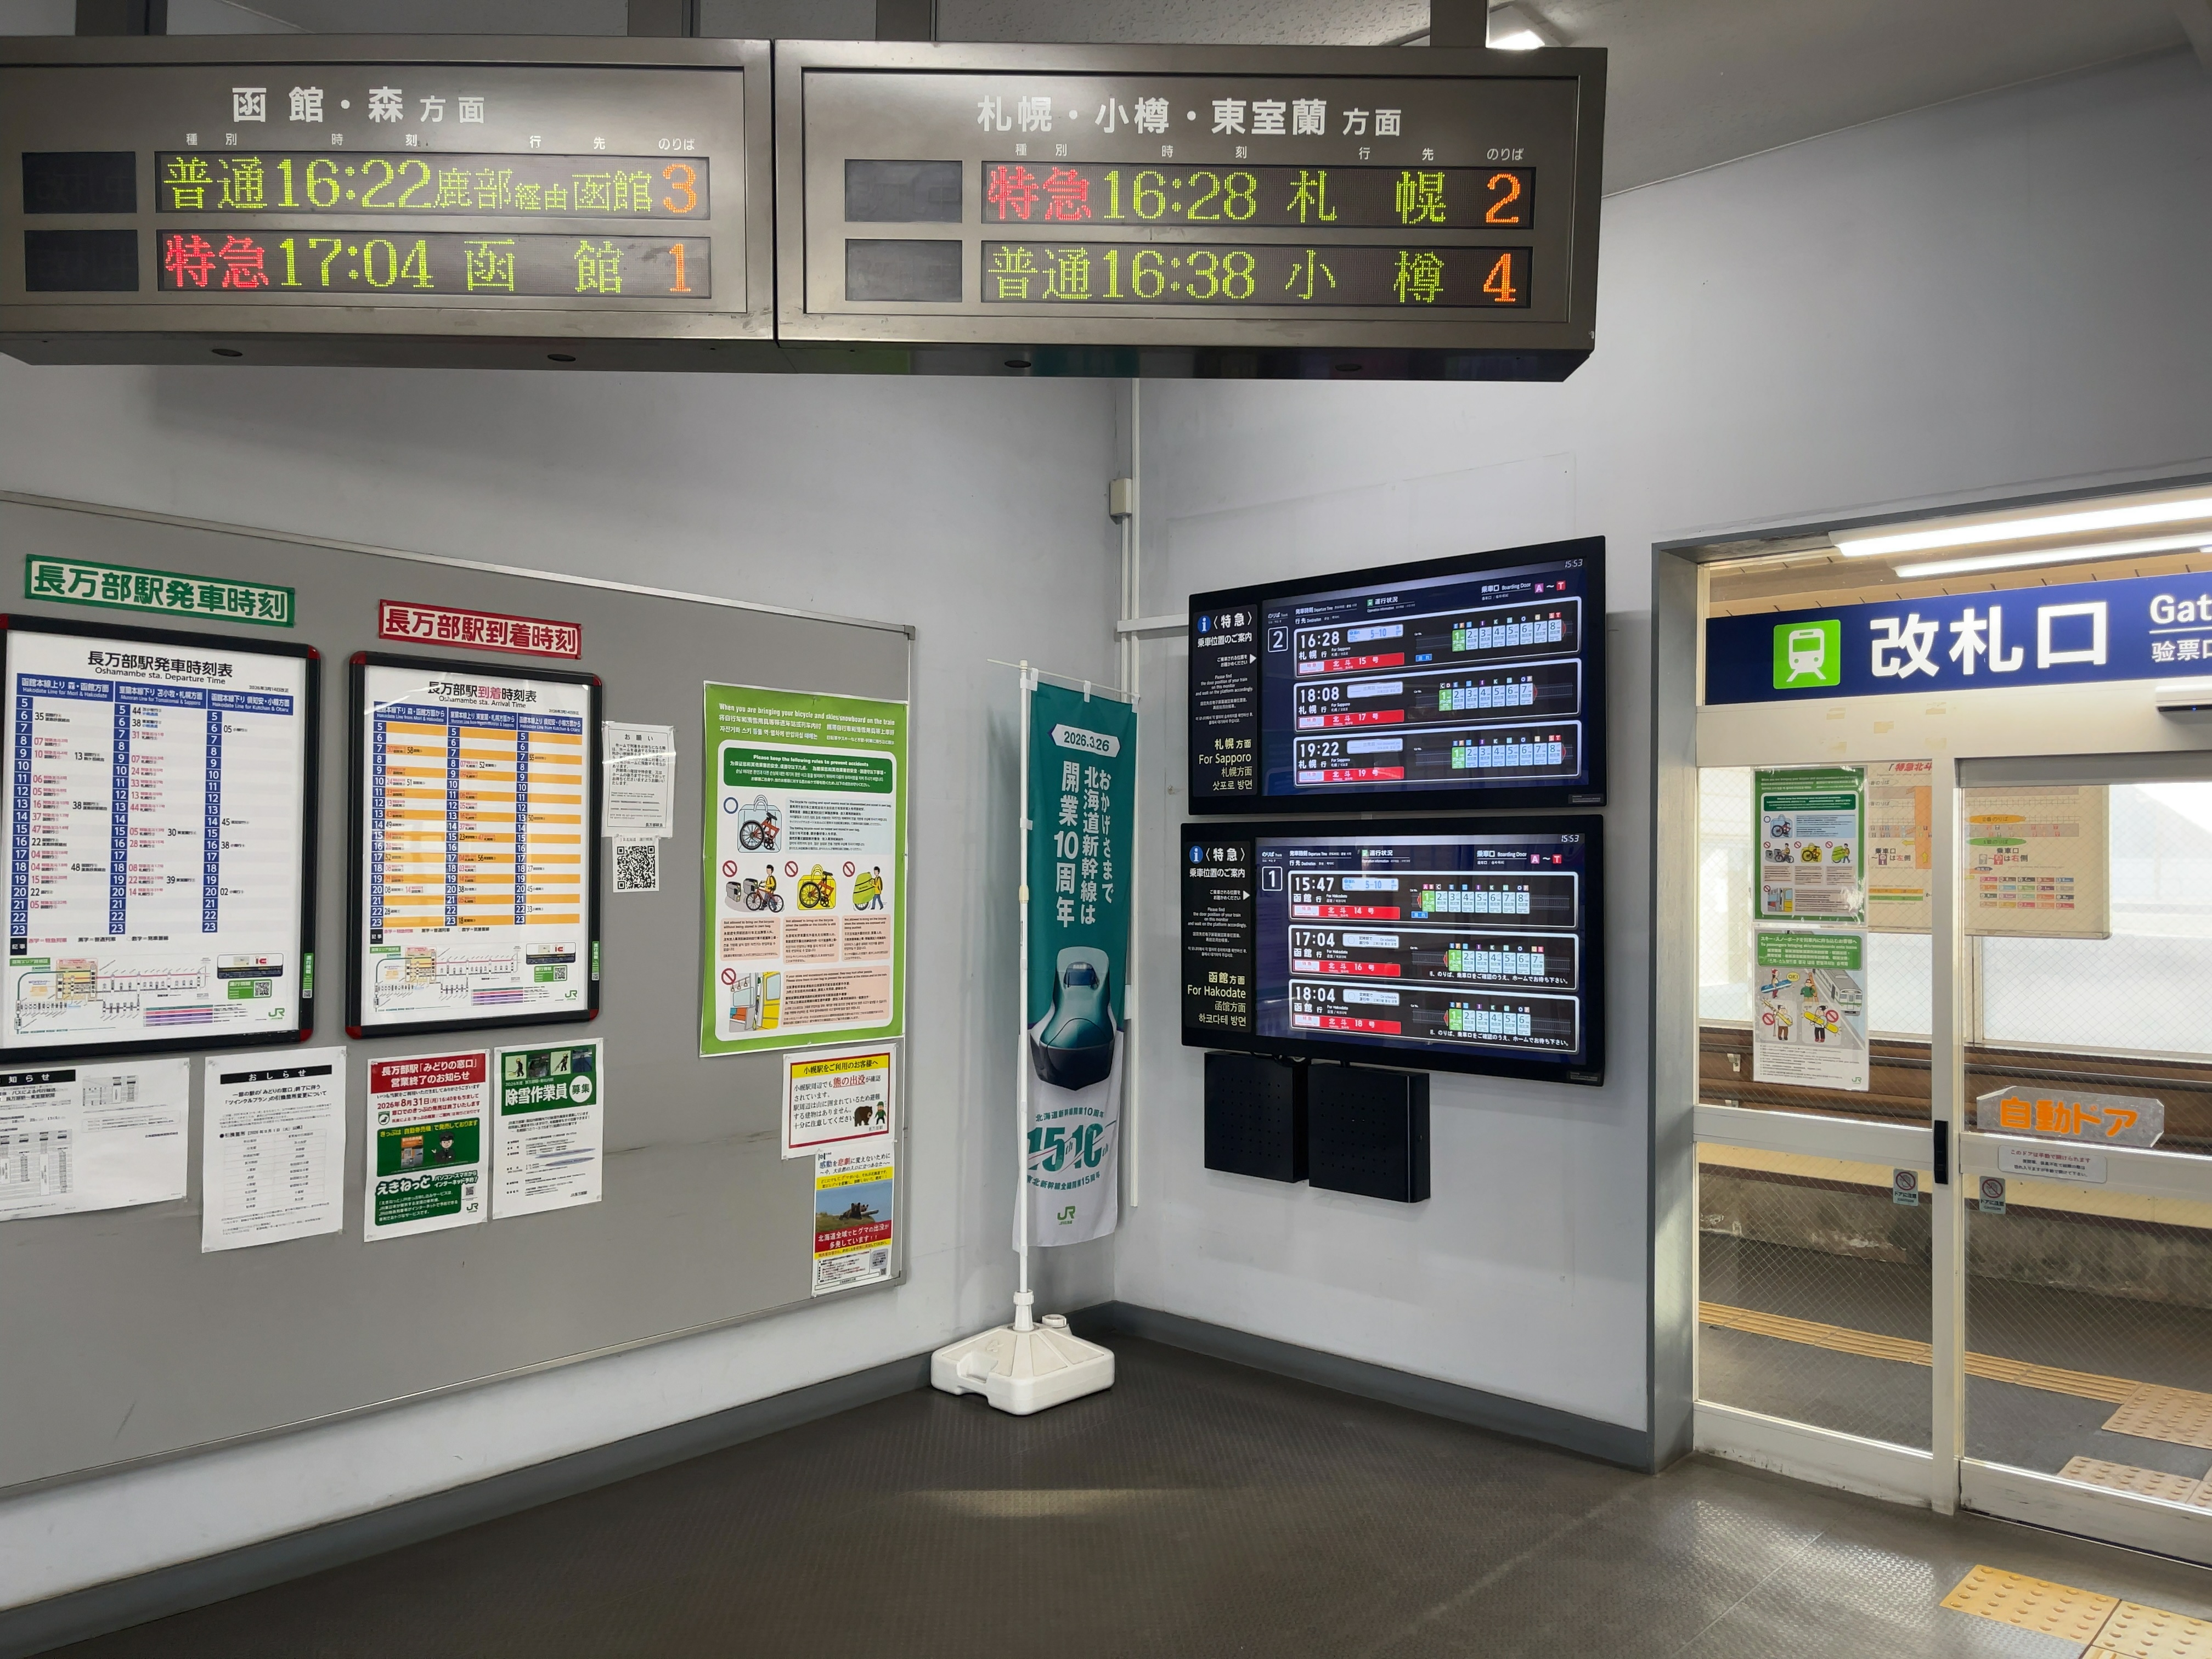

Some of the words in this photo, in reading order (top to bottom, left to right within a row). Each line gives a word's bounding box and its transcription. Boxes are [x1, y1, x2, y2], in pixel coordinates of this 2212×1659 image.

[186, 133, 238, 146] 種別
[331, 133, 417, 147] 時刻
[529, 136, 605, 150] 行先
[658, 137, 696, 152] のりば
[1015, 143, 1068, 156] 種別
[1161, 145, 1248, 159] 時刻
[1358, 146, 1434, 162] 行先
[1486, 147, 1524, 162] のりば
[163, 156, 266, 210] 普通
[277, 158, 432, 208] 16:22
[661, 163, 697, 213] 3
[988, 166, 1092, 221] 特急
[1102, 170, 1258, 221] 16:28
[1286, 171, 1447, 224] 札幌
[1485, 172, 1522, 224] 2
[163, 234, 268, 289] 特急
[280, 238, 433, 289] 17:04
[464, 239, 624, 294] 函館
[668, 244, 691, 292] 1
[988, 245, 1091, 301] 普通
[1102, 249, 1257, 299] 16:38
[1285, 250, 1444, 303] 小樽
[1483, 253, 1516, 303] 4
[1565, 558, 1583, 568] 15:53
[34, 565, 287, 620] 長万部駅発車時刻
[386, 608, 577, 654] 長万部駅到着時刻
[1273, 630, 1283, 648] 2
[1198, 632, 1252, 647] 乗車位置のご案内
[1301, 631, 1339, 648] 16:28
[1870, 601, 2109, 679] 改札口
[88, 651, 233, 678] 長万部駅発車時刻表
[95, 667, 146, 678] Oshamambe
[165, 673, 204, 683] Departure
[207, 676, 225, 685] Time
[427, 681, 537, 702] 長万部駅到着時刻表
[439, 695, 477, 704] Oshamambe
[1301, 686, 1339, 703] 18:08
[719, 703, 735, 712] When
[758, 708, 780, 716] bringing
[795, 710, 813, 719] bicycle
[211, 724, 217, 732] 6
[224, 725, 232, 733] 05
[1064, 731, 1109, 752] 2026.3.26
[1214, 738, 1251, 751] 札幌方面
[1300, 742, 1339, 758] 19:22
[1199, 754, 1213, 765] For
[1215, 752, 1251, 768] Sapporo
[1221, 766, 1252, 778] 札幌方面
[1212, 781, 1235, 791] 삿포로
[1237, 780, 1252, 790] 방면
[208, 817, 218, 826] 14
[222, 818, 230, 826] 45
[1054, 760, 1080, 928] 開業10周年
[1099, 770, 1114, 904] おかげさまで
[1561, 834, 1579, 843] 15:53
[1080, 766, 1099, 925] 北海道新幹線は
[1189, 868, 1245, 878] 乗車位置のご案内
[1268, 870, 1275, 887] 1
[206, 888, 216, 896] 20
[220, 888, 228, 896] 02
[1295, 877, 1334, 891] 15:47
[1296, 932, 1335, 947] 17:04
[1208, 971, 1245, 985] 函館方面
[1188, 985, 1201, 996] For
[1204, 986, 1246, 998] Hakodate
[1296, 986, 1335, 1003] 18:04
[268, 1008, 285, 1017] JR
[1215, 1002, 1246, 1013] 函馆方面
[1199, 1014, 1228, 1026] 하코다테
[1231, 1017, 1246, 1027] 방면
[804, 1059, 878, 1074] 小幌駅をご利用のお客様へ
[0, 1073, 50, 1084] 知らせ
[249, 1069, 306, 1081] おしらせ
[391, 1071, 470, 1088] 営業終了のお知らせ
[505, 1082, 567, 1107] 除雪作業員
[572, 1084, 590, 1095] 募集
[794, 1092, 830, 1102] されています。
[793, 1107, 851, 1120] する建物はありません。
[2000, 1096, 2138, 1137] 自動ドア
[377, 1176, 431, 1195] えきねっと
[1057, 1206, 1076, 1220] JR
